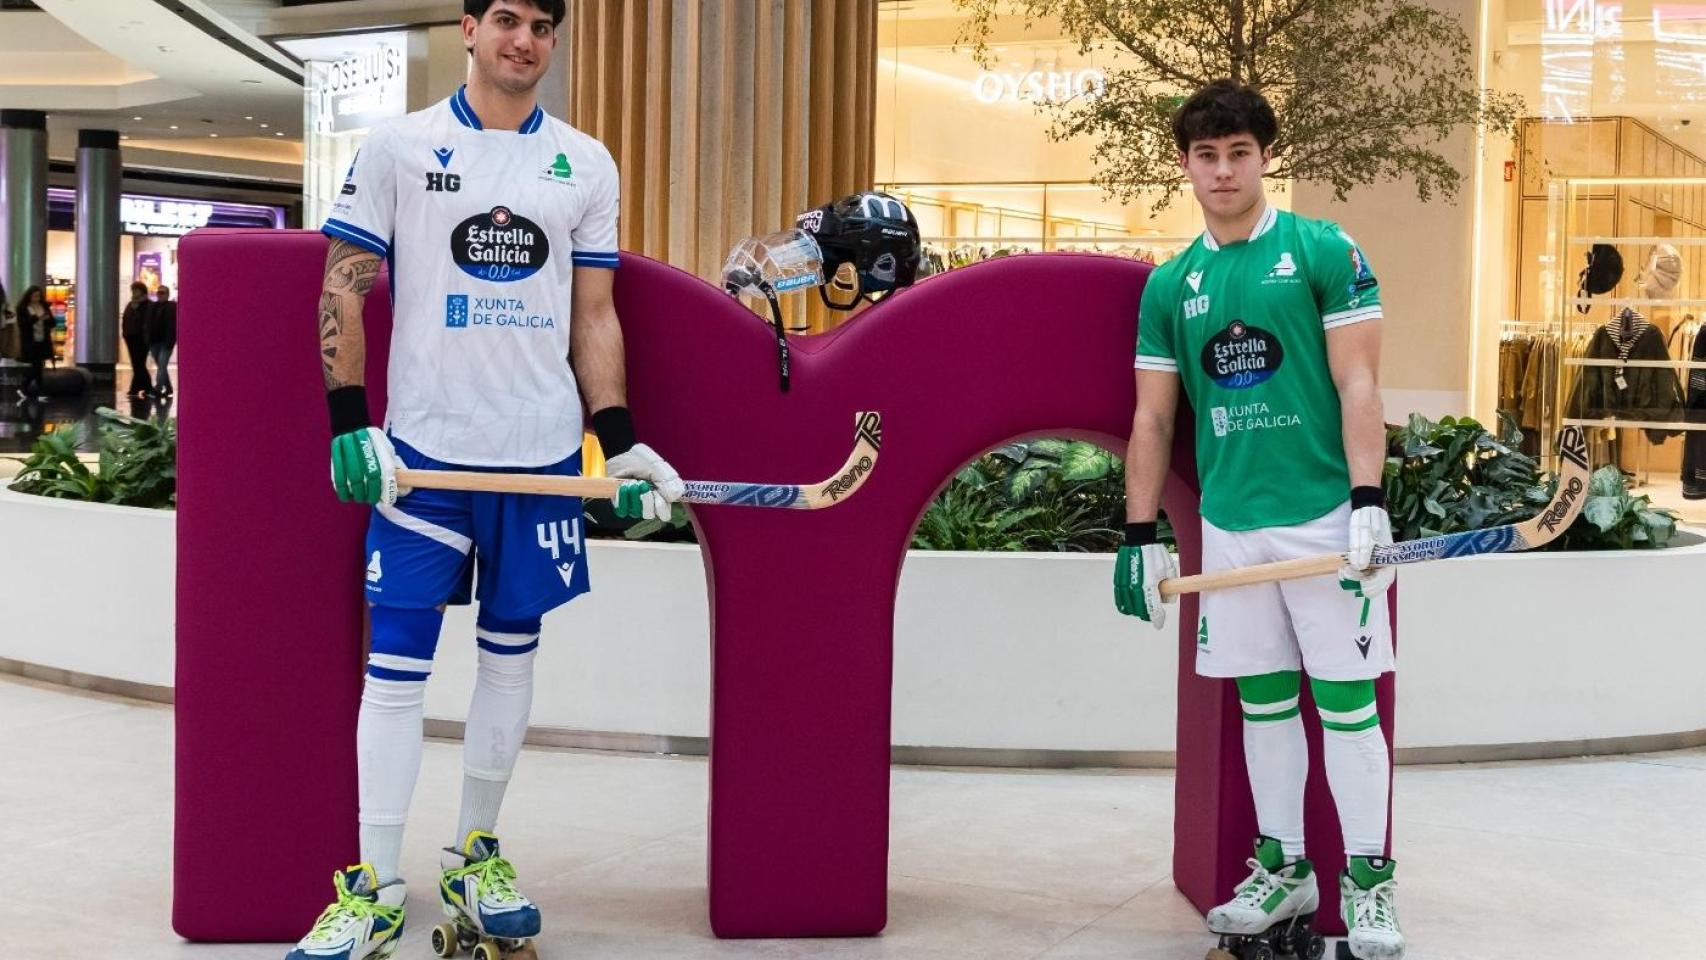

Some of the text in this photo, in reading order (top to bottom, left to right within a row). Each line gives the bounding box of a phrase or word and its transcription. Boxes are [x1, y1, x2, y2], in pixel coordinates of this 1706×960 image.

[974, 69, 1104, 104] OYSHO
[426, 172, 461, 192] HG
[465, 225, 534, 246] Estrella
[468, 243, 531, 264] Galicia
[474, 298, 525, 311] XUNTA
[1183, 295, 1209, 319] HG
[473, 313, 555, 329] DE GALICIA
[1213, 338, 1268, 359] Estrella
[1216, 355, 1266, 375] Galicia
[1228, 402, 1270, 418] XUNTA
[1227, 415, 1302, 432] DE GALICIA
[821, 456, 872, 501] Reno
[1537, 476, 1583, 534] Reno
[537, 518, 581, 559] 44
[1401, 539, 1445, 553] WORLD
[1375, 549, 1436, 565] CHAMPION
